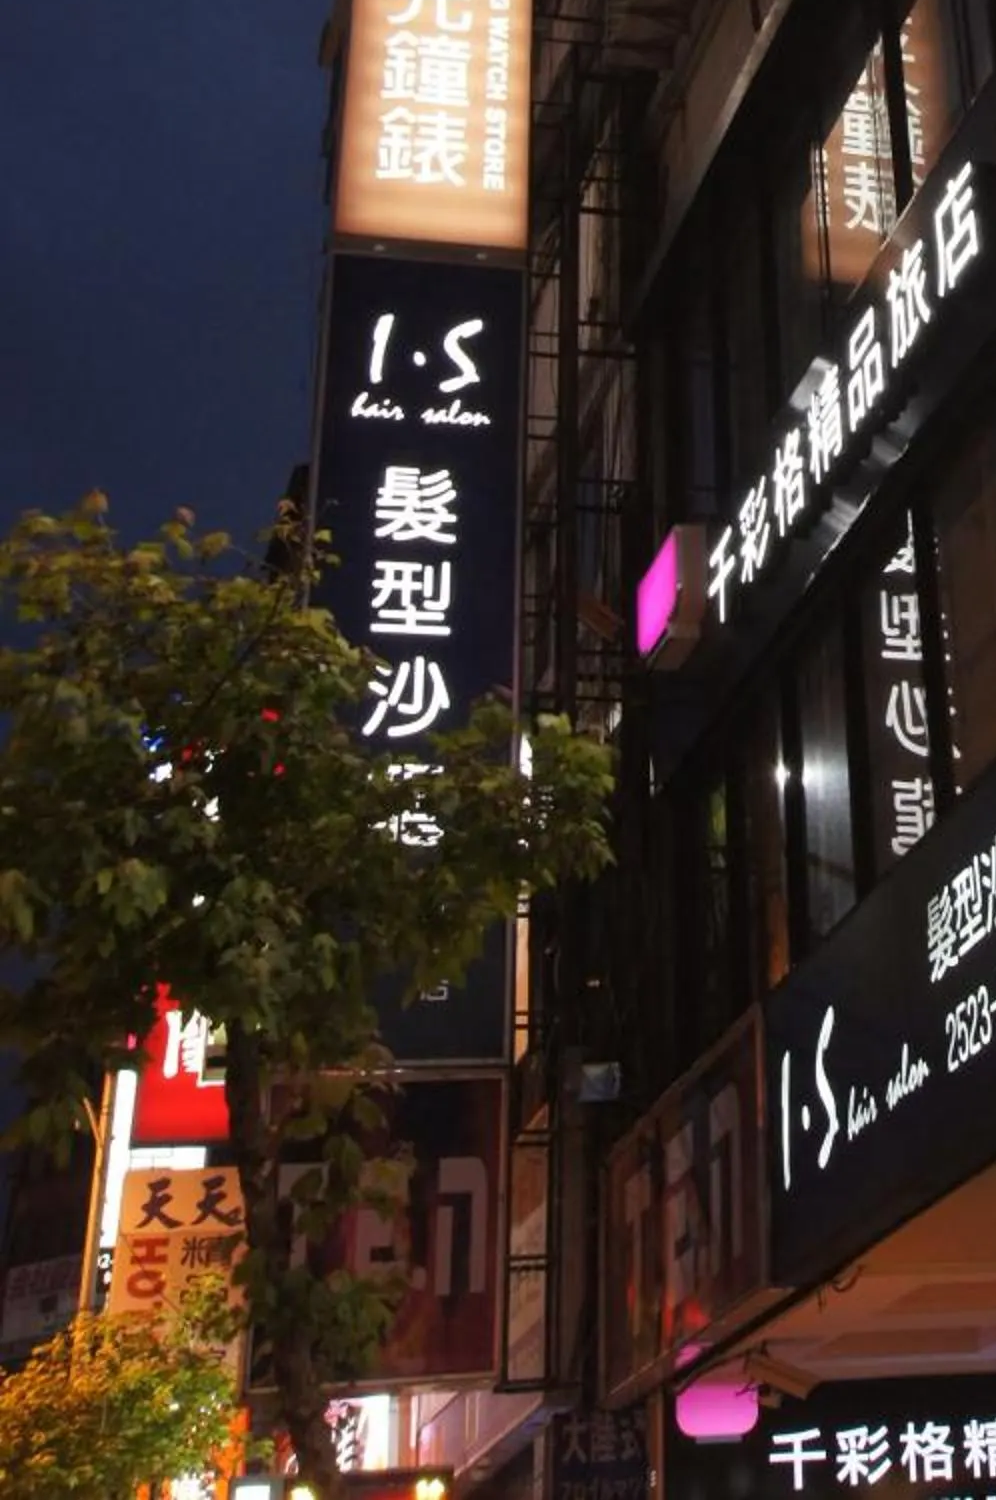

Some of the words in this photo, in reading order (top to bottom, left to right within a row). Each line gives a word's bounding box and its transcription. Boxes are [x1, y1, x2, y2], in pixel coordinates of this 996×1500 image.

[485, 16, 510, 101] WATCH
[482, 106, 508, 190] STORE
[351, 391, 405, 421] hair
[707, 162, 979, 623] 千彩格精品旅店
